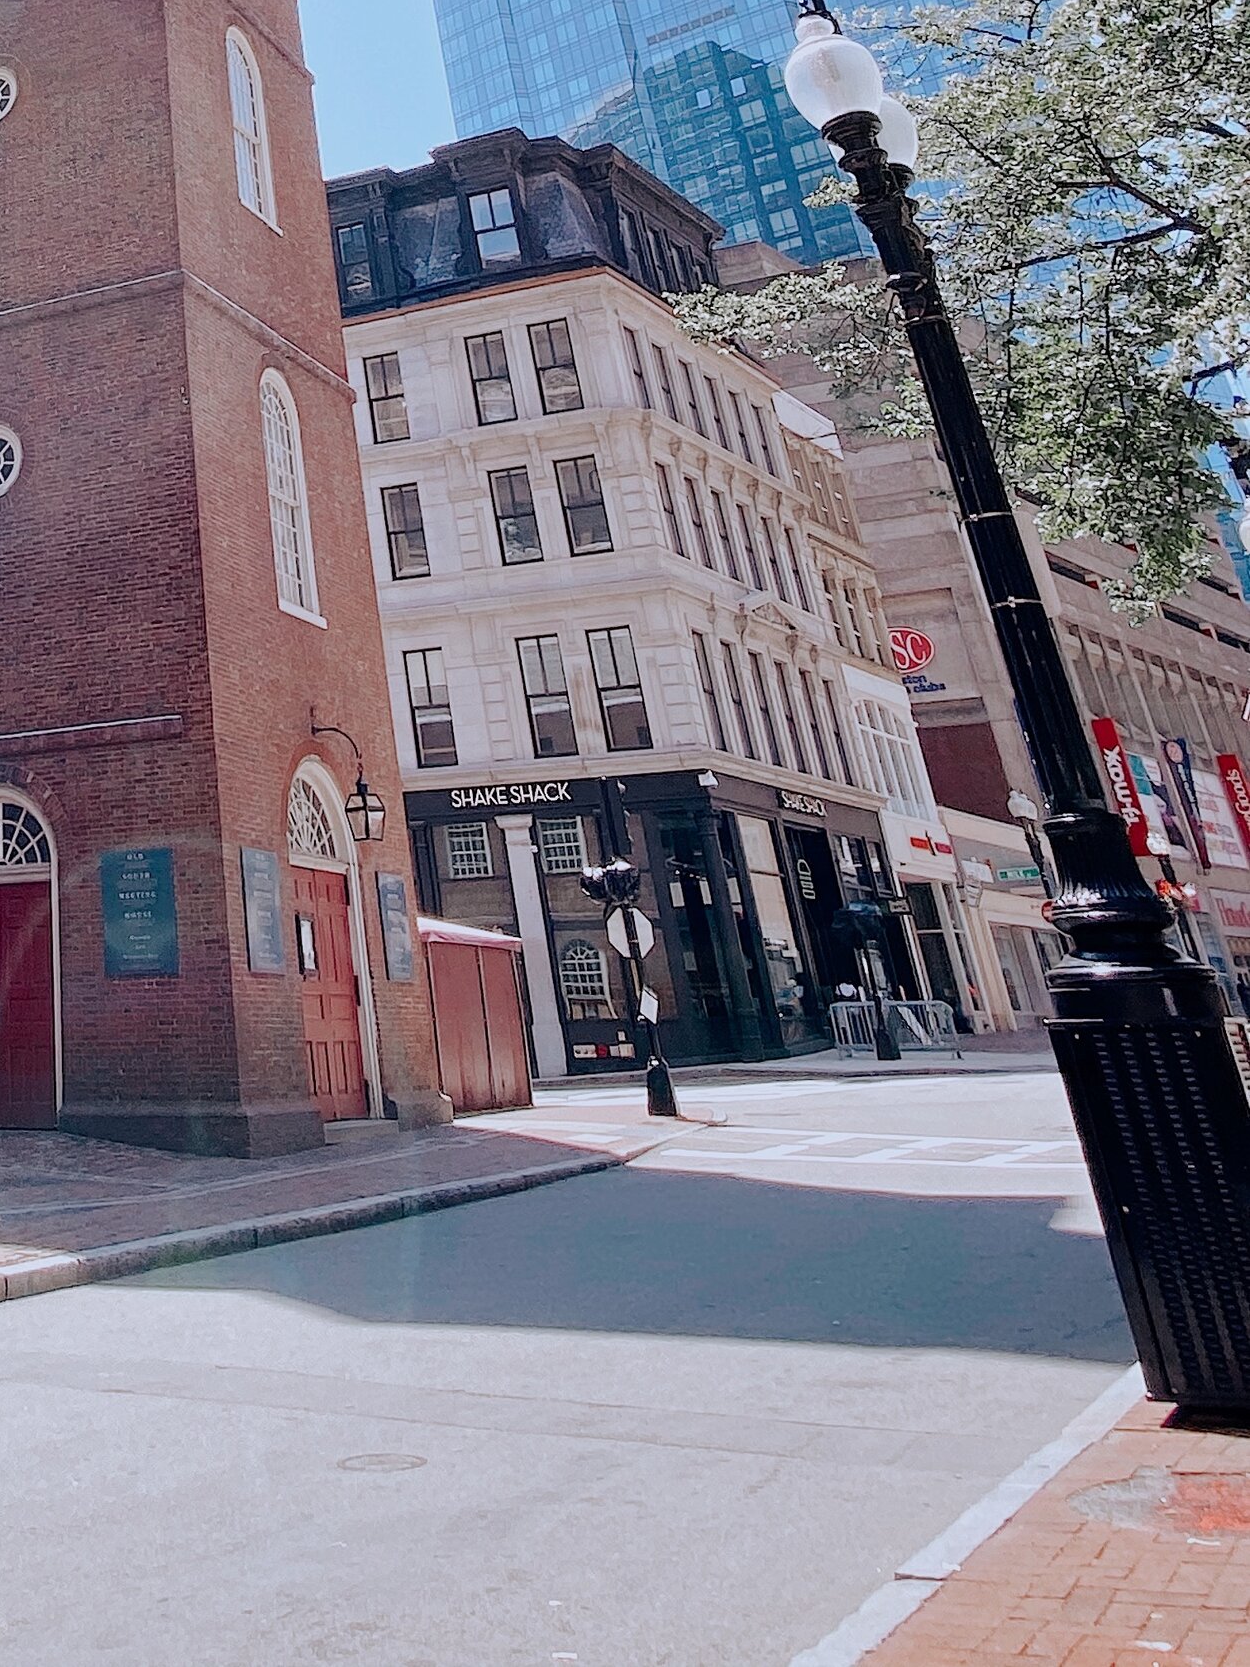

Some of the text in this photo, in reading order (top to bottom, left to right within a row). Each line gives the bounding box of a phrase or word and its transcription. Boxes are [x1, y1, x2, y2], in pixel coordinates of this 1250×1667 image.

[889, 632, 926, 669] SC
[451, 782, 571, 808] SHAKE SHACK
